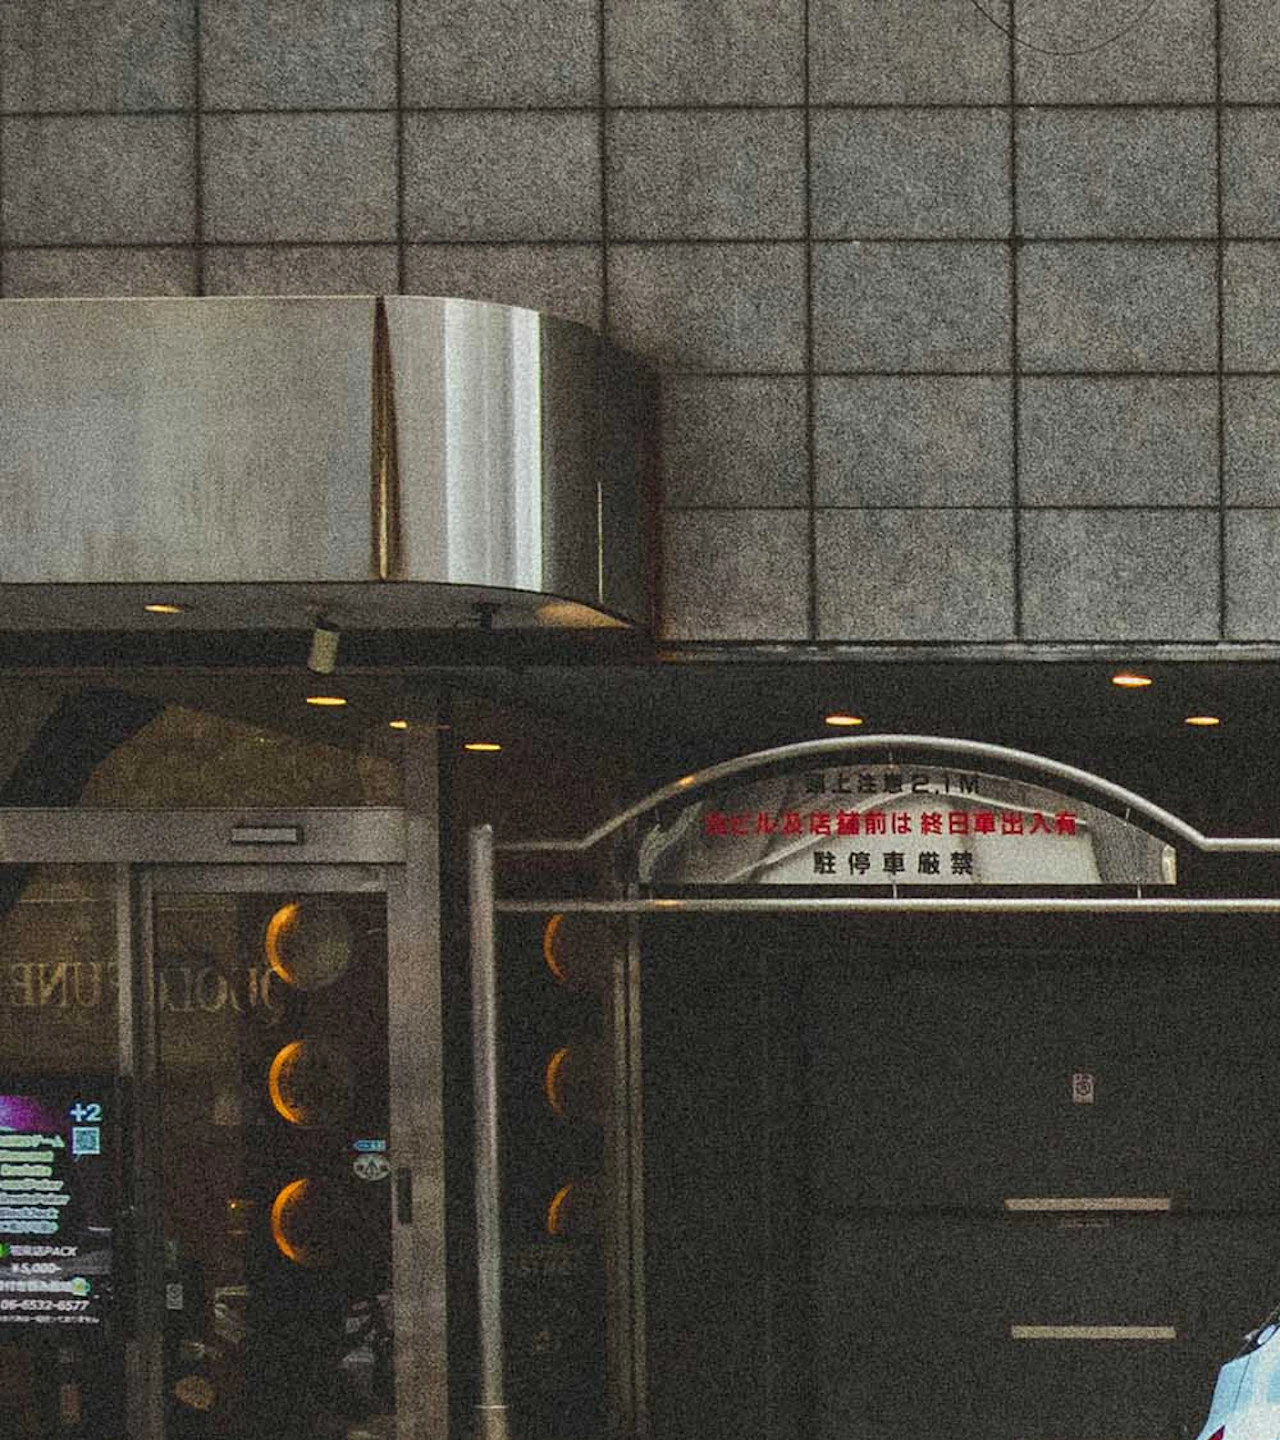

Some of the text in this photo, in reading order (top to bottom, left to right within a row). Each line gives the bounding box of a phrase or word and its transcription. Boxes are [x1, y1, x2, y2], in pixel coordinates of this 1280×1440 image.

[813, 851, 974, 876] 駐停車厳禁
